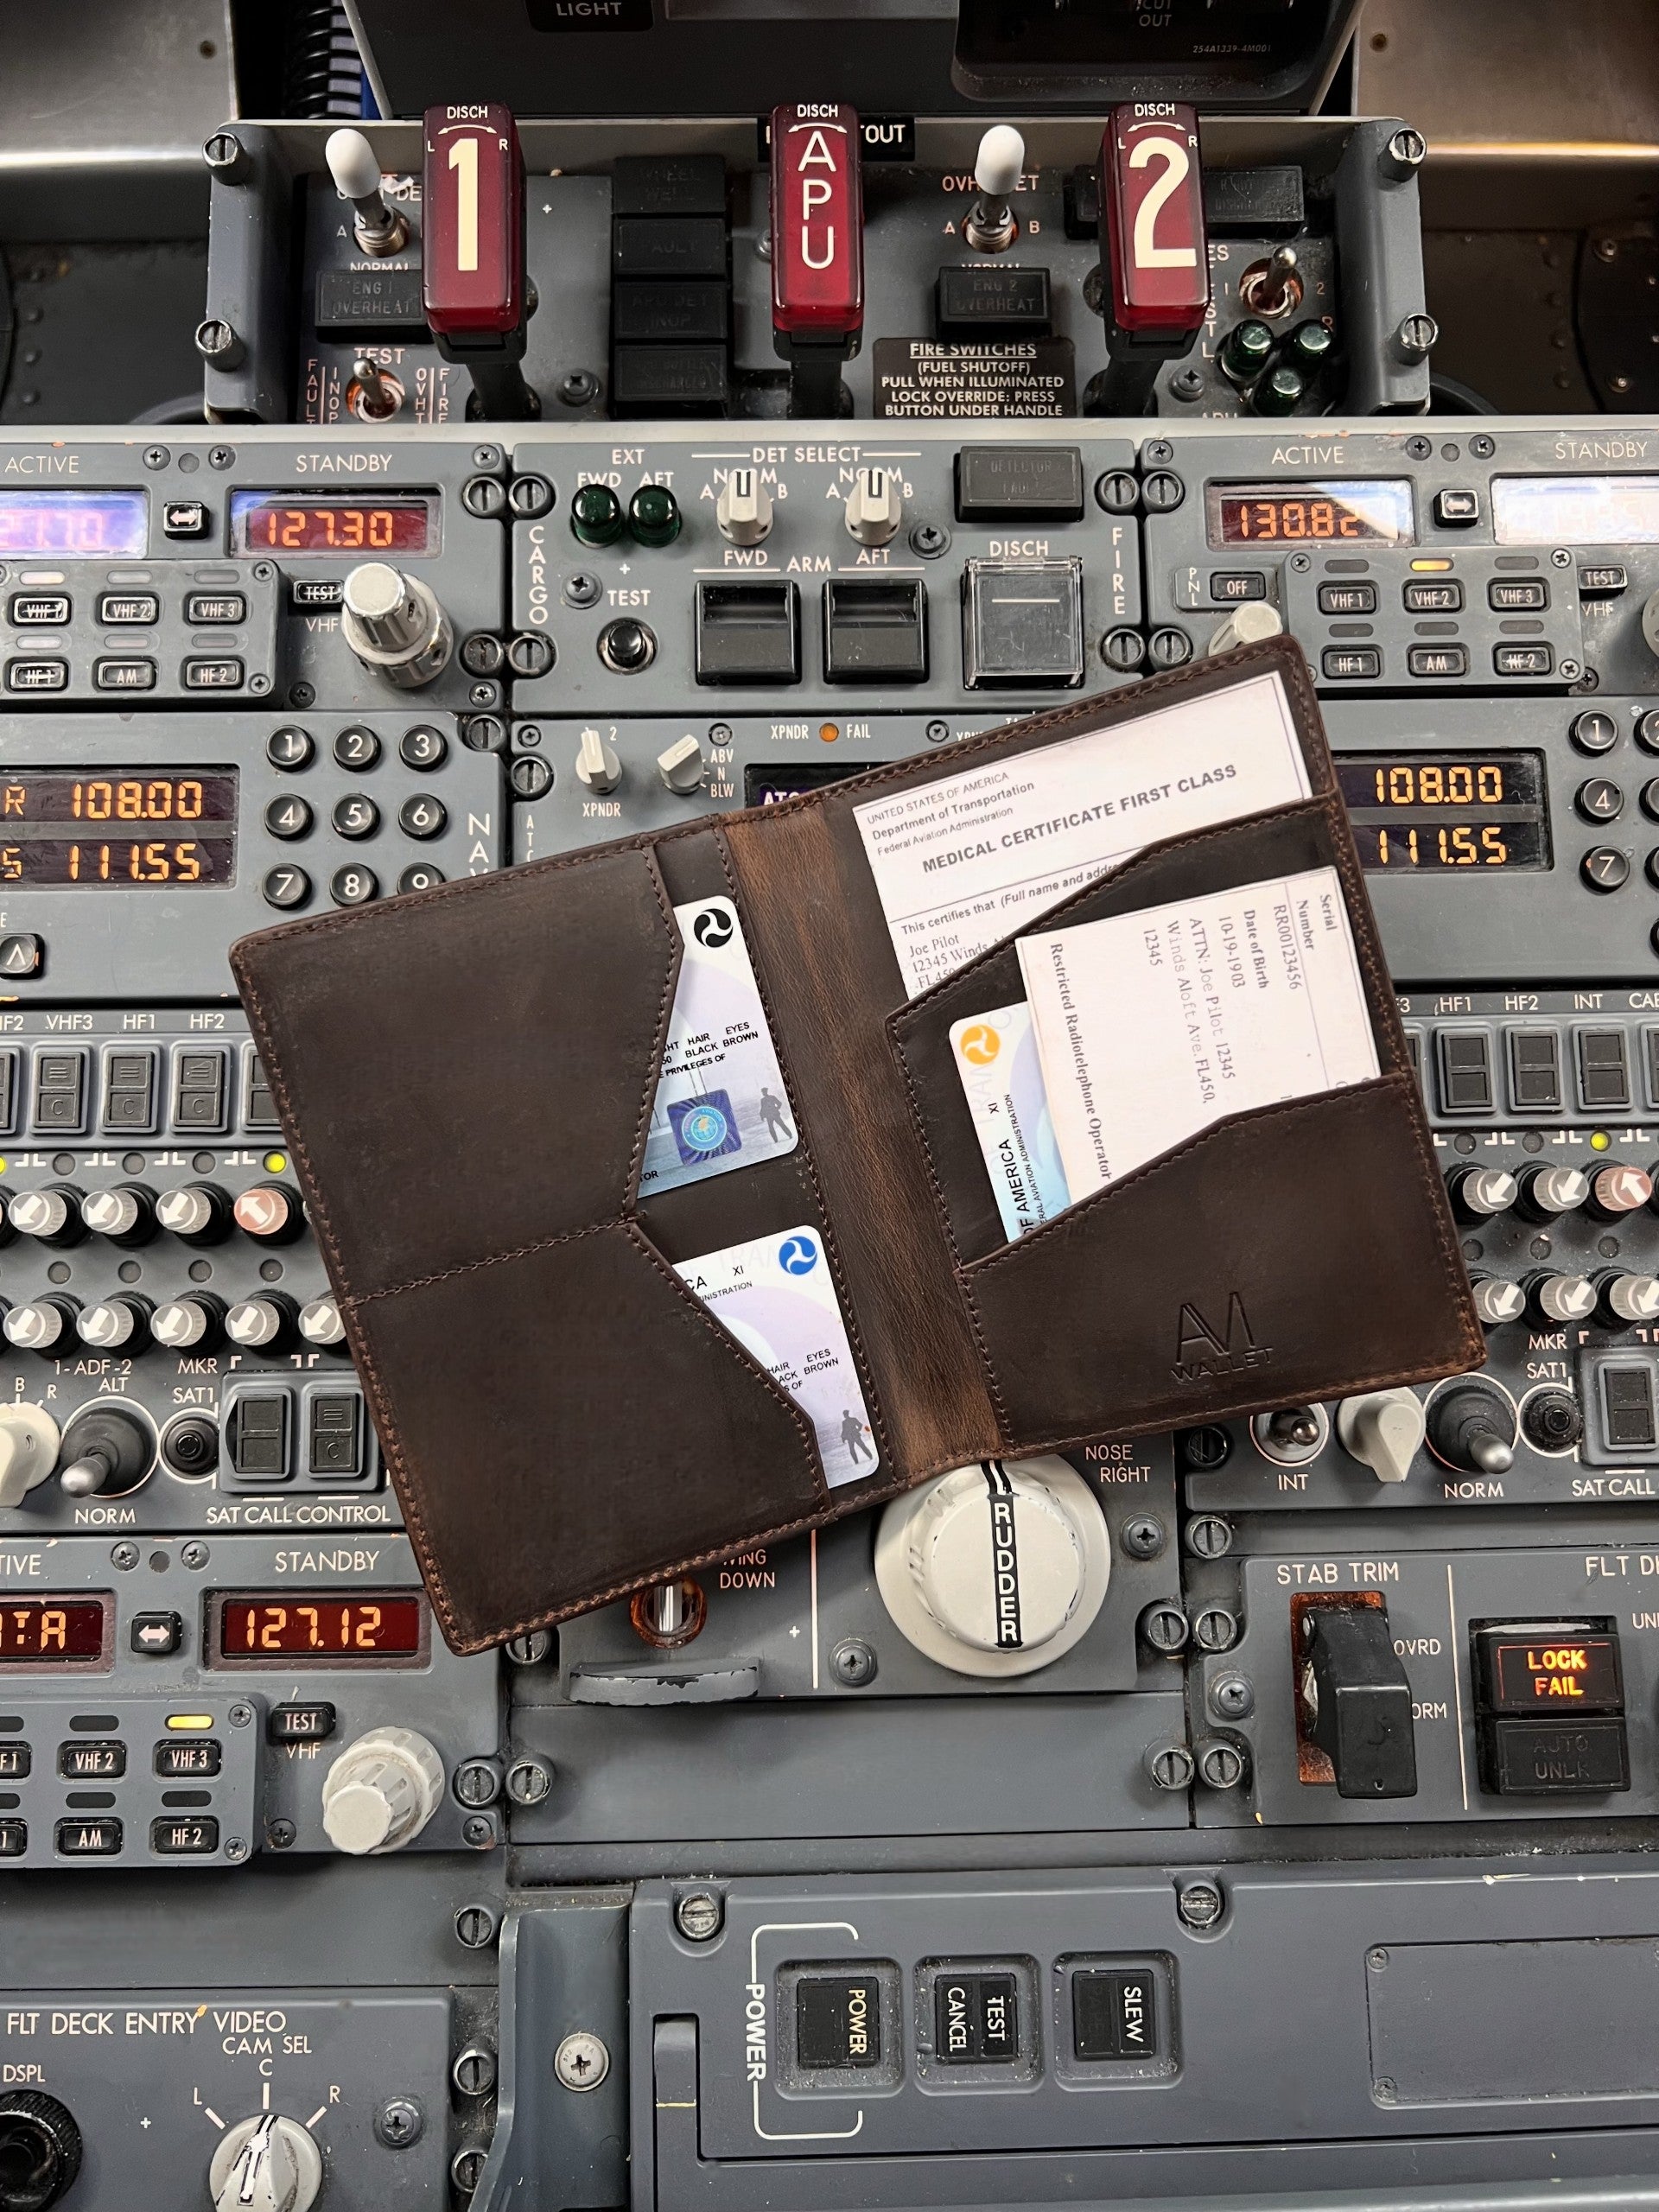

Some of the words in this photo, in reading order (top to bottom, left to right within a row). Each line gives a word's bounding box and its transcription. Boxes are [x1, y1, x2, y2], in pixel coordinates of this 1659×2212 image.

[556, 2, 622, 16] LIGHT
[1139, 14, 1173, 27] OUT
[447, 105, 487, 119] DISCH
[797, 104, 838, 118] DISCH
[1134, 103, 1175, 117] DISCH
[448, 137, 479, 271] 1
[798, 130, 836, 269] APU
[1128, 137, 1198, 269] 2
[353, 347, 405, 365] TEST
[910, 343, 944, 356] FIRE
[950, 343, 1037, 357] SWITCHES
[918, 362, 956, 375] (FUEL
[961, 361, 1030, 375] SHUTOFF)
[881, 377, 915, 388] PULL
[919, 377, 964, 388] WHEN
[969, 377, 1064, 388] ILLUMINATED
[891, 391, 931, 403] LOCK
[934, 391, 1010, 403] OVERRIDE:
[1014, 391, 1055, 403] PRESS
[885, 405, 944, 416] BUTTON
[949, 405, 1000, 416] UNDER
[1004, 405, 1063, 416] HANDLE
[612, 449, 645, 465] EXT
[753, 448, 788, 463] DET
[794, 447, 861, 462] SELECT
[1271, 447, 1344, 465] ACTIVE
[1555, 442, 1649, 459] STANDBY
[4, 456, 79, 473] ACTIVE
[296, 454, 393, 473] STANDBY
[268, 511, 393, 547] 127.30
[724, 550, 768, 566] FWD
[855, 549, 891, 565] AFT
[988, 541, 1049, 556] DISCH
[786, 556, 832, 572] ARM
[1112, 527, 1124, 615] FIRE
[528, 526, 548, 624] CARGO
[1586, 570, 1614, 585] TEST
[1226, 580, 1248, 595] OFF
[607, 589, 651, 606] TEST
[306, 618, 338, 632] VHF
[771, 724, 810, 740] XPNDR
[846, 723, 871, 740] FAIL
[710, 748, 734, 763] ABV
[710, 783, 734, 798] BLW
[1376, 766, 1503, 804] 108.00
[72, 782, 202, 819] 108.00
[868, 805, 904, 824] UNITED
[906, 792, 944, 812] STATES
[947, 787, 960, 799] OF
[963, 772, 1010, 794] AMERICA
[582, 803, 621, 817] XPNDR
[872, 812, 936, 841] Department
[938, 807, 950, 820] of
[951, 781, 1035, 815] Transportation
[922, 840, 997, 874] MEDICAL
[1001, 802, 1116, 848] CERTIFICATE
[1120, 783, 1172, 811] FIRST
[1178, 764, 1237, 793] CLASS
[877, 836, 911, 856] Federal
[913, 826, 948, 846] Aviation
[950, 805, 1014, 833] Administration
[1379, 826, 1508, 864] 111.55
[69, 843, 200, 880] 111.55
[901, 921, 925, 936] This
[928, 908, 971, 928] certifies
[973, 900, 995, 915] that
[1001, 890, 1026, 908] (Full
[1028, 882, 1059, 898] name
[1062, 870, 1084, 887] and
[1319, 893, 1338, 931] Serial
[1243, 910, 1257, 939] Date
[1297, 899, 1315, 950] Number
[909, 943, 929, 958] Joe
[931, 934, 960, 951] Pilot
[1143, 929, 1163, 967] 12345
[1189, 918, 1210, 964] ATTN:
[1250, 940, 1262, 954] of
[1274, 904, 1303, 990] RR00123456
[1218, 915, 1246, 988] 10-19-1903
[912, 951, 948, 974] 12345
[1167, 920, 1185, 973] Winds
[1178, 976, 1197, 1019] Aloft
[1199, 968, 1213, 992] Joe
[1252, 958, 1270, 989] Birth
[1440, 996, 1471, 1012] HF1
[1504, 995, 1539, 1011] HF2
[1574, 994, 1603, 1009] INT
[49, 1014, 93, 1030] VHF3
[124, 1014, 156, 1029] HF1
[189, 1013, 225, 1029] HF2
[1205, 996, 1224, 1036] Pilot
[688, 1033, 710, 1046] HAIR
[726, 1022, 750, 1035] EYES
[685, 1043, 719, 1058] BLACK
[723, 1031, 759, 1048] BROWN
[1050, 943, 1072, 1011] Restricted
[1065, 1014, 1096, 1115] Radiotelephone
[1089, 1117, 1112, 1179] Operator
[1215, 1042, 1236, 1079] 12345
[1004, 1093, 1028, 1162] ADMINISTRATION
[1001, 1138, 1031, 1212] AMERICA
[1023, 1161, 1040, 1203] AVIATION
[1529, 1334, 1567, 1350] MKR
[806, 1348, 831, 1363] EYES
[1171, 1348, 1274, 1382] WALLET
[177, 1358, 218, 1374] MKR
[804, 1357, 839, 1376] BROWN
[1526, 1362, 1567, 1379] SAT1
[98, 1377, 128, 1392] ALT
[173, 1387, 214, 1403] SAT1
[1085, 1445, 1133, 1460] NOSE
[1100, 1466, 1151, 1484] RIGHT
[1278, 1473, 1308, 1491] INT
[1444, 1481, 1504, 1499] NORM
[1572, 1479, 1604, 1497] SAT
[1608, 1478, 1655, 1496] CALL
[74, 1508, 137, 1524] NORM
[207, 1507, 241, 1524] SAT
[246, 1506, 292, 1523] CALL
[297, 1504, 391, 1523] CONTROL
[274, 1550, 379, 1573] STANDBY
[1586, 1555, 1629, 1577] FLT
[719, 1573, 776, 1589] DOWN
[994, 1502, 1018, 1642] RUDDER
[1276, 1563, 1338, 1585] STAB
[1350, 1561, 1399, 1583] TRIM
[245, 1605, 382, 1649] 127.12
[1394, 1639, 1441, 1656] OVRD
[1528, 1649, 1588, 1670] LOCK
[1535, 1677, 1585, 1696] FAIL
[285, 1713, 317, 1731] TEST
[285, 1742, 321, 1760] VHF
[1534, 1735, 1589, 1753] AUTO
[1535, 1762, 1590, 1780] UNLK
[7, 2012, 41, 2036] FLT
[51, 2012, 114, 2036] DECK
[125, 2011, 198, 2036] ENTRY
[213, 2010, 286, 2034] VIDEO
[848, 1988, 867, 2055] POWER
[947, 1986, 969, 2051] CANCEL
[987, 1995, 1006, 2042] TEST
[1122, 1986, 1144, 2044] SLEW
[745, 1983, 766, 2082] POWER
[221, 2037, 273, 2055] CAM
[282, 2035, 313, 2054] SEL
[3, 2064, 46, 2083] DSPL
